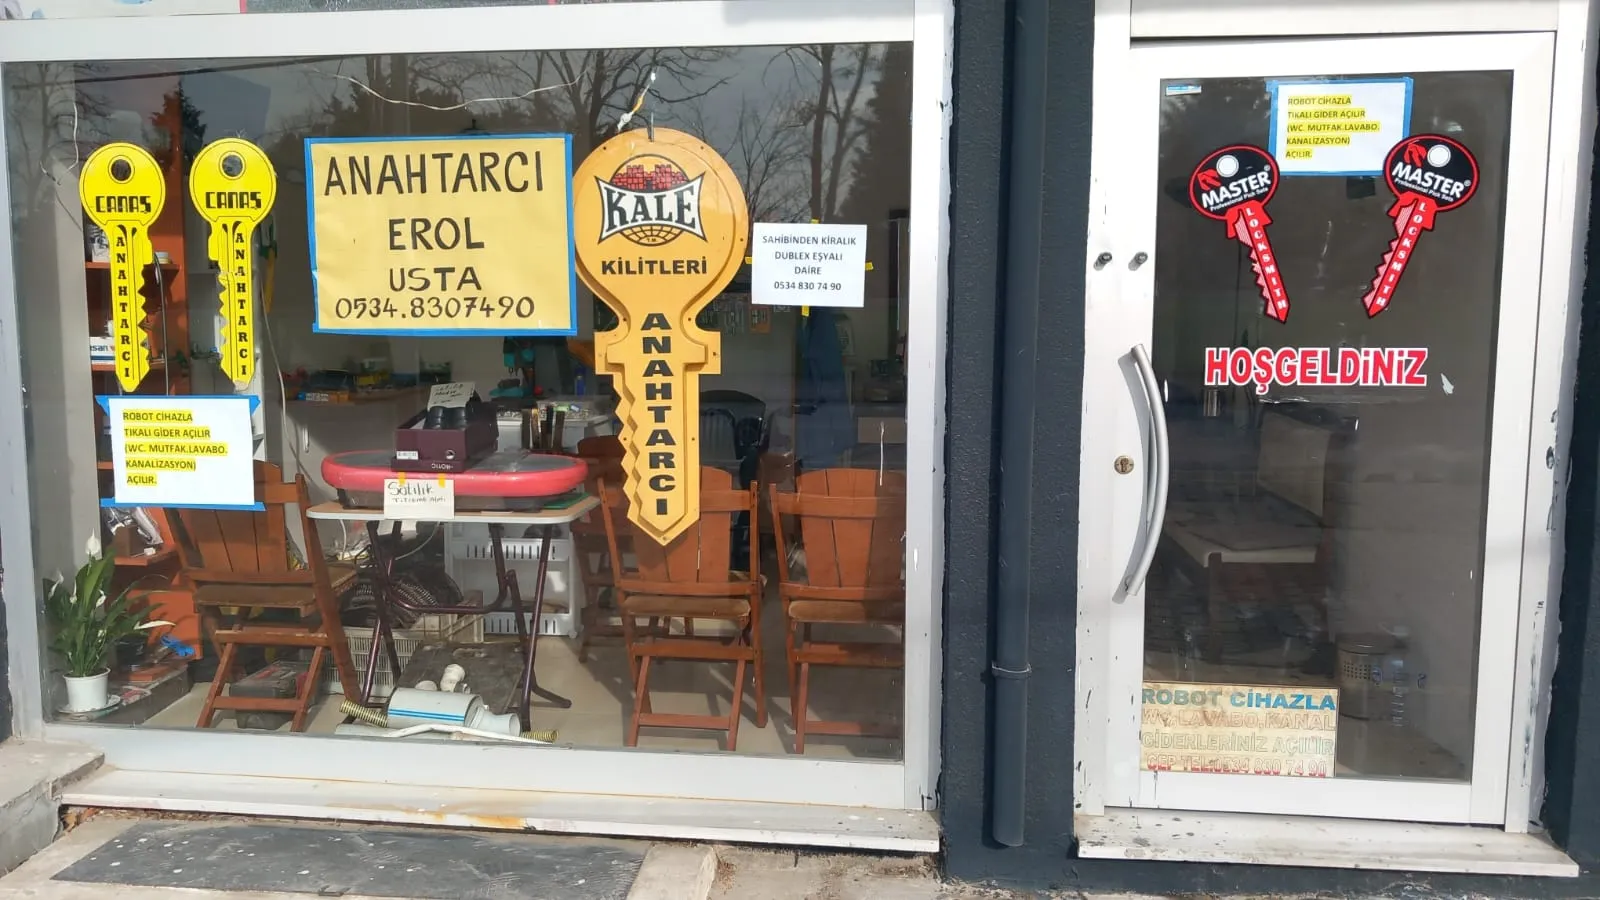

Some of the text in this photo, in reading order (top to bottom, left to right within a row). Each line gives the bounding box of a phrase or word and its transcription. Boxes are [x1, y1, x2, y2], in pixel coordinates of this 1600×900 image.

[1318, 96, 1352, 105] CİHAZLA
[1288, 110, 1365, 119] TIKALI GİDER AÇILIR
[1286, 136, 1351, 145] KANALİZASYON)
[324, 151, 543, 196] ANAHTARCI
[603, 185, 696, 233] KALE
[388, 216, 485, 251] EROL
[762, 233, 857, 246] SAHİBİNDEN KİRALIK
[601, 256, 707, 275] KİLİTLERİ
[775, 251, 843, 262] DUBLEX EŞYALI
[1375, 201, 1426, 307] LOCKSMITH
[389, 266, 482, 292] USTA
[794, 266, 822, 275] DAİRE
[773, 281, 842, 291] 0534 830 74 90
[116, 236, 131, 378] ANAHTARCI
[234, 232, 249, 376] ANAHTARCI
[335, 296, 535, 319] 0534.8307490
[123, 411, 193, 421] ROBOT CİHAZLA
[641, 312, 676, 516] ANAHTARCI
[124, 427, 211, 439] TIKALI GİDER AÇILIR
[125, 459, 197, 471] KANALİZASYON)
[1142, 688, 1336, 711] ROBOT CİHAZLA
[1142, 729, 1268, 753] GİDERLERİNİZ
[1146, 754, 1176, 771] CEP
[1286, 758, 1305, 776] 74
[1309, 759, 1327, 778] 90
